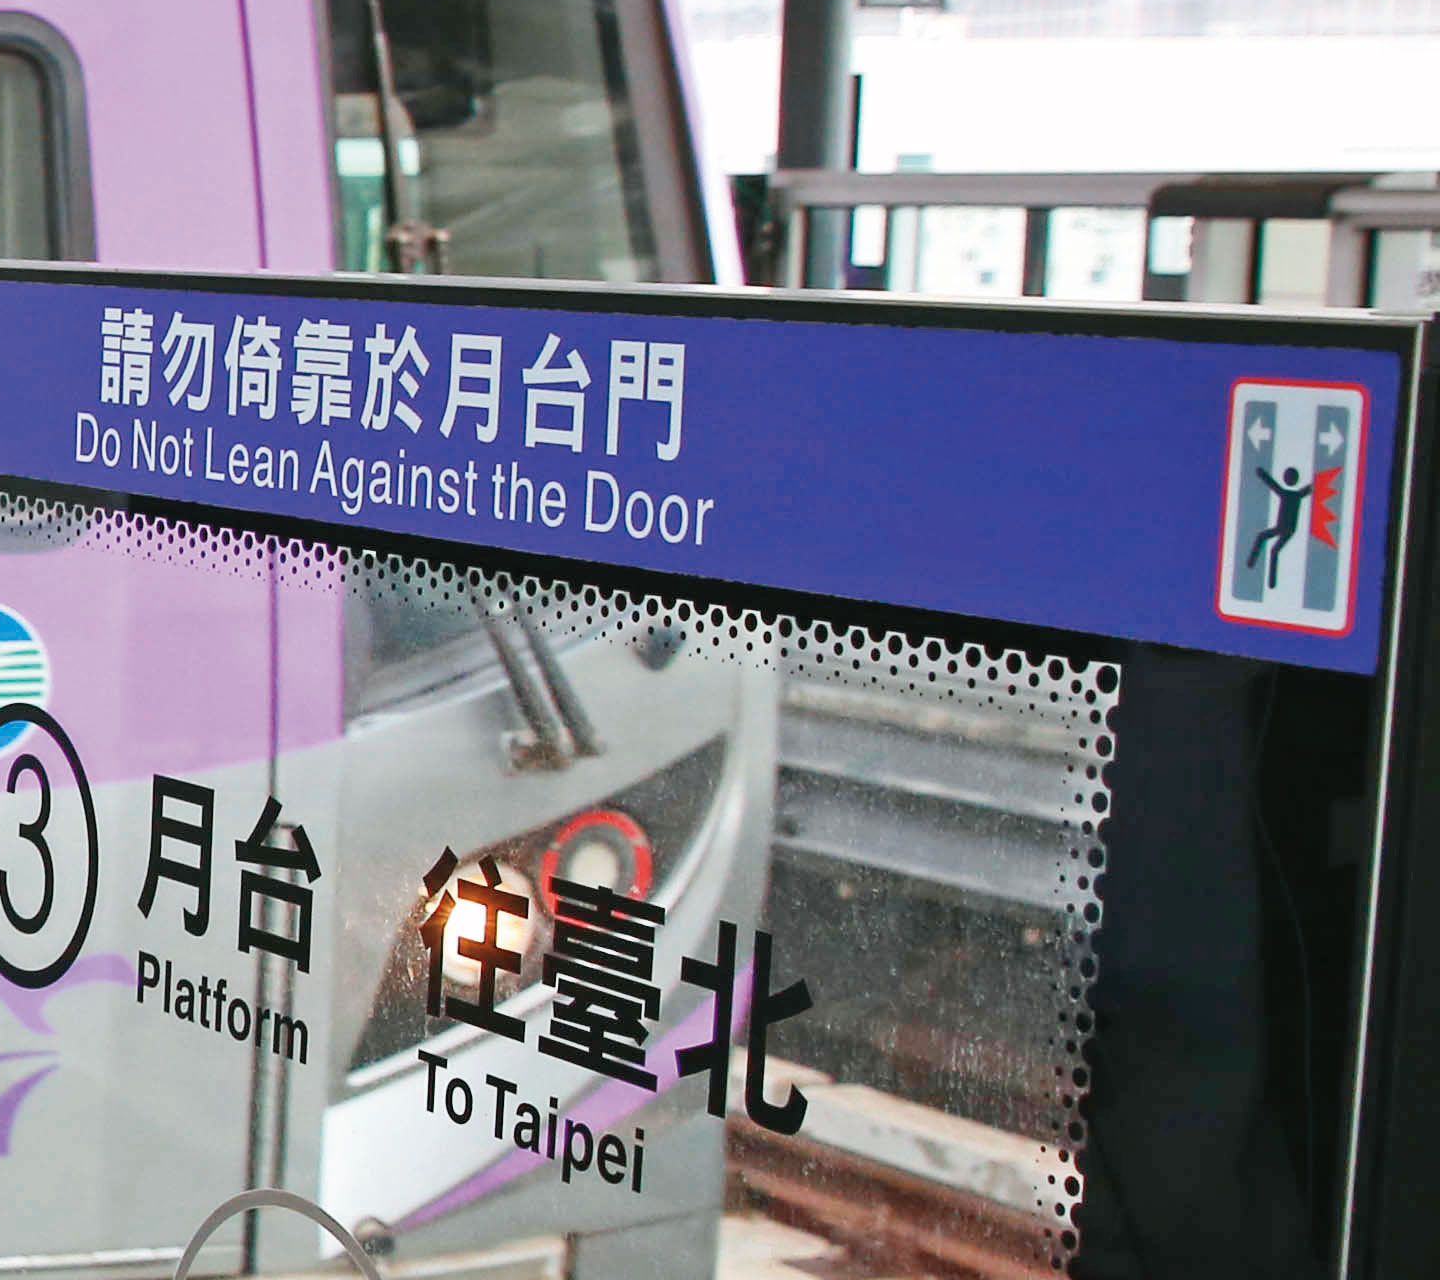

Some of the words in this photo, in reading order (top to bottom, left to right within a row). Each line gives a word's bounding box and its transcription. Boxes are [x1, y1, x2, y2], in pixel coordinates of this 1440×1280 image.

[99, 307, 685, 461] 請勿倚靠於月台門
[75, 412, 120, 468] Do
[132, 420, 193, 480] Not
[205, 427, 299, 491] Lean
[310, 439, 477, 515] Against
[492, 457, 566, 528] the
[585, 469, 715, 546] Door
[137, 774, 322, 974] 月台
[137, 950, 308, 1065] Platform
[419, 846, 814, 1136] 往臺北
[418, 1049, 473, 1125] To
[486, 1074, 645, 1194] Taipei
